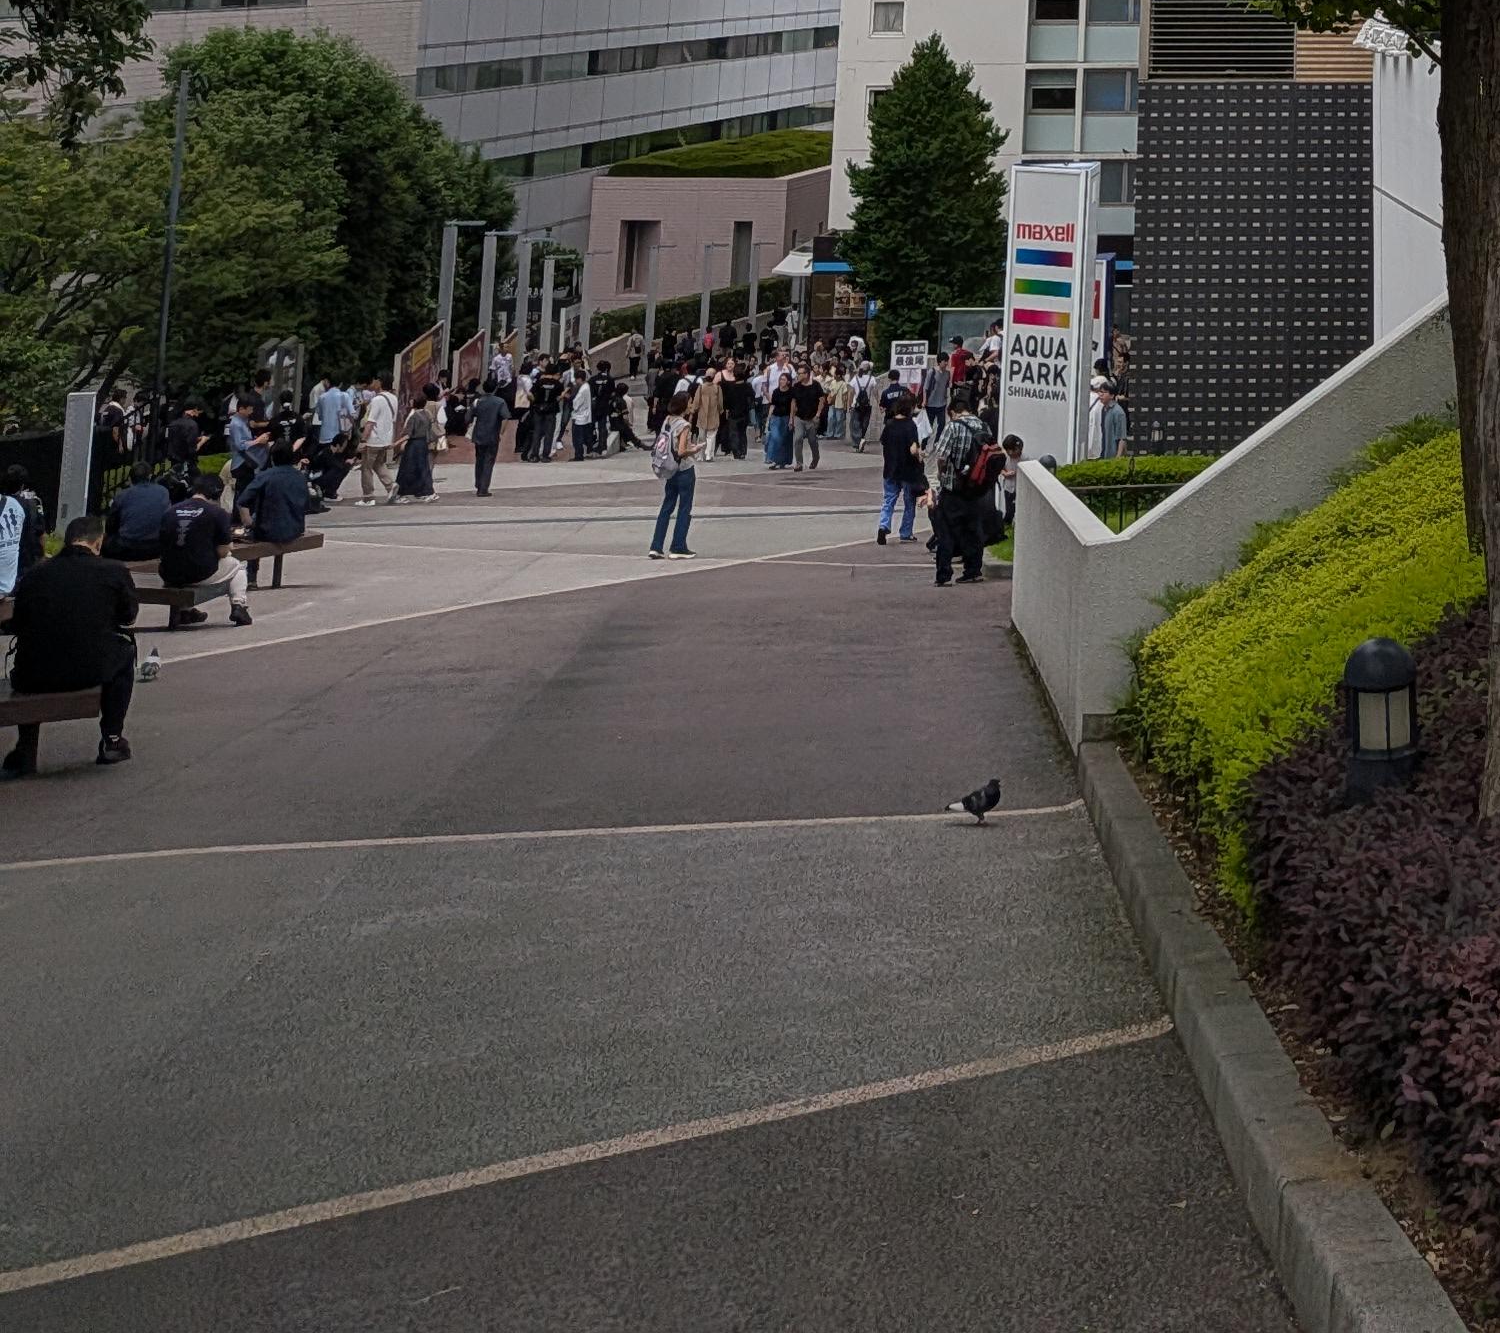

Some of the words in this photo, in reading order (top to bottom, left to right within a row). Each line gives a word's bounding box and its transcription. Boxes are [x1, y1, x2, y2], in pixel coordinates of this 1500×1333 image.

[1016, 223, 1075, 243] maxell
[1010, 333, 1068, 361] AQUA
[1009, 360, 1068, 387] PARK
[1008, 385, 1067, 402] SHINAGAWA
